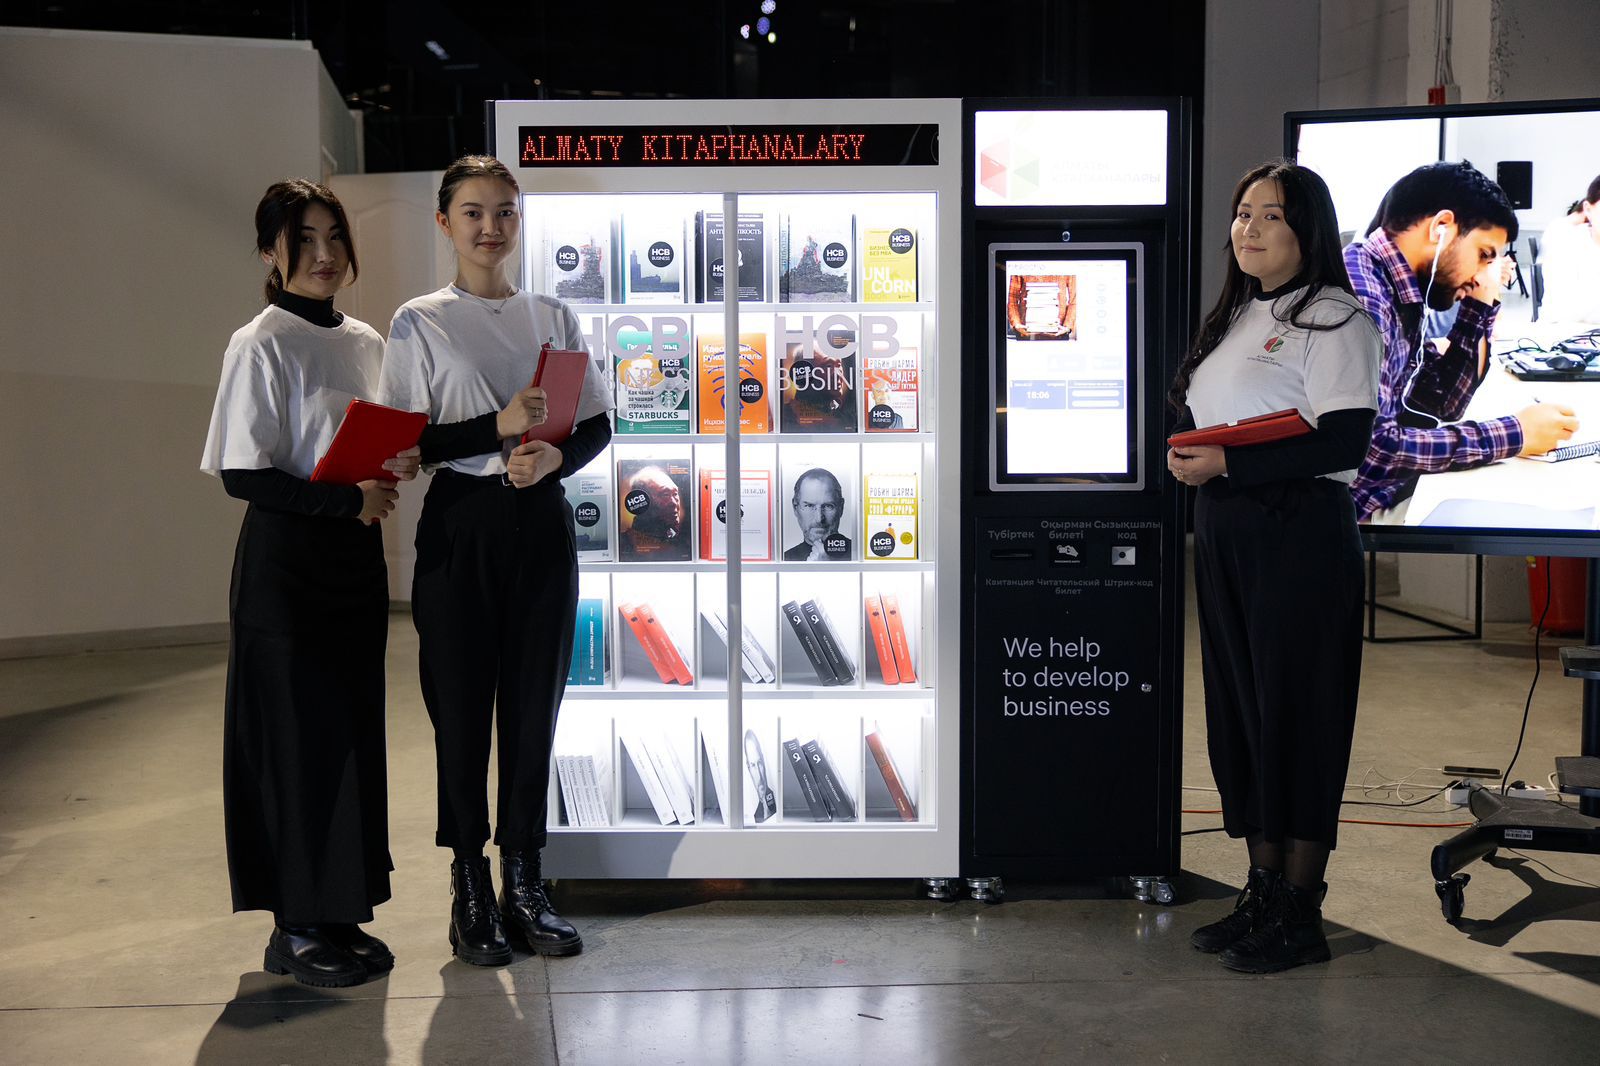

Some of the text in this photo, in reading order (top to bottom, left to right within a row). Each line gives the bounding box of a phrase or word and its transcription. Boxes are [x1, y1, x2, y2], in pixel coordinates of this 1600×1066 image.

[521, 133, 866, 162] ALMATY KITAPHANALARY
[892, 234, 911, 242] HCB
[559, 252, 576, 260] HCB
[652, 248, 671, 256] HCB
[864, 266, 890, 280] UNI
[872, 280, 916, 295] CORN
[774, 314, 900, 359] HCB
[662, 358, 681, 367] HCB
[776, 366, 903, 391] BUSINESS
[892, 370, 917, 382] ЛИДЕР
[741, 384, 760, 392] HCB
[628, 411, 679, 420] STARBUCKS
[872, 410, 892, 418] HCB
[870, 487, 914, 496] РОБИН ШАРМА
[627, 494, 646, 508] HCB
[578, 508, 597, 516] HCB
[1040, 520, 1092, 530] Оқырман
[1094, 520, 1161, 530] Сызықшалы
[988, 530, 1035, 540] Түбіртек
[1048, 530, 1084, 540] билеті
[1117, 532, 1137, 540] код
[874, 538, 892, 546] HCB
[986, 578, 1034, 587] Квитанция
[1037, 578, 1100, 587] Читательский
[1104, 579, 1154, 587] Штрих-код
[1055, 587, 1082, 595] билет
[1003, 636, 1101, 662] We help
[1002, 666, 1130, 692] to develop
[1004, 696, 1111, 716] business
